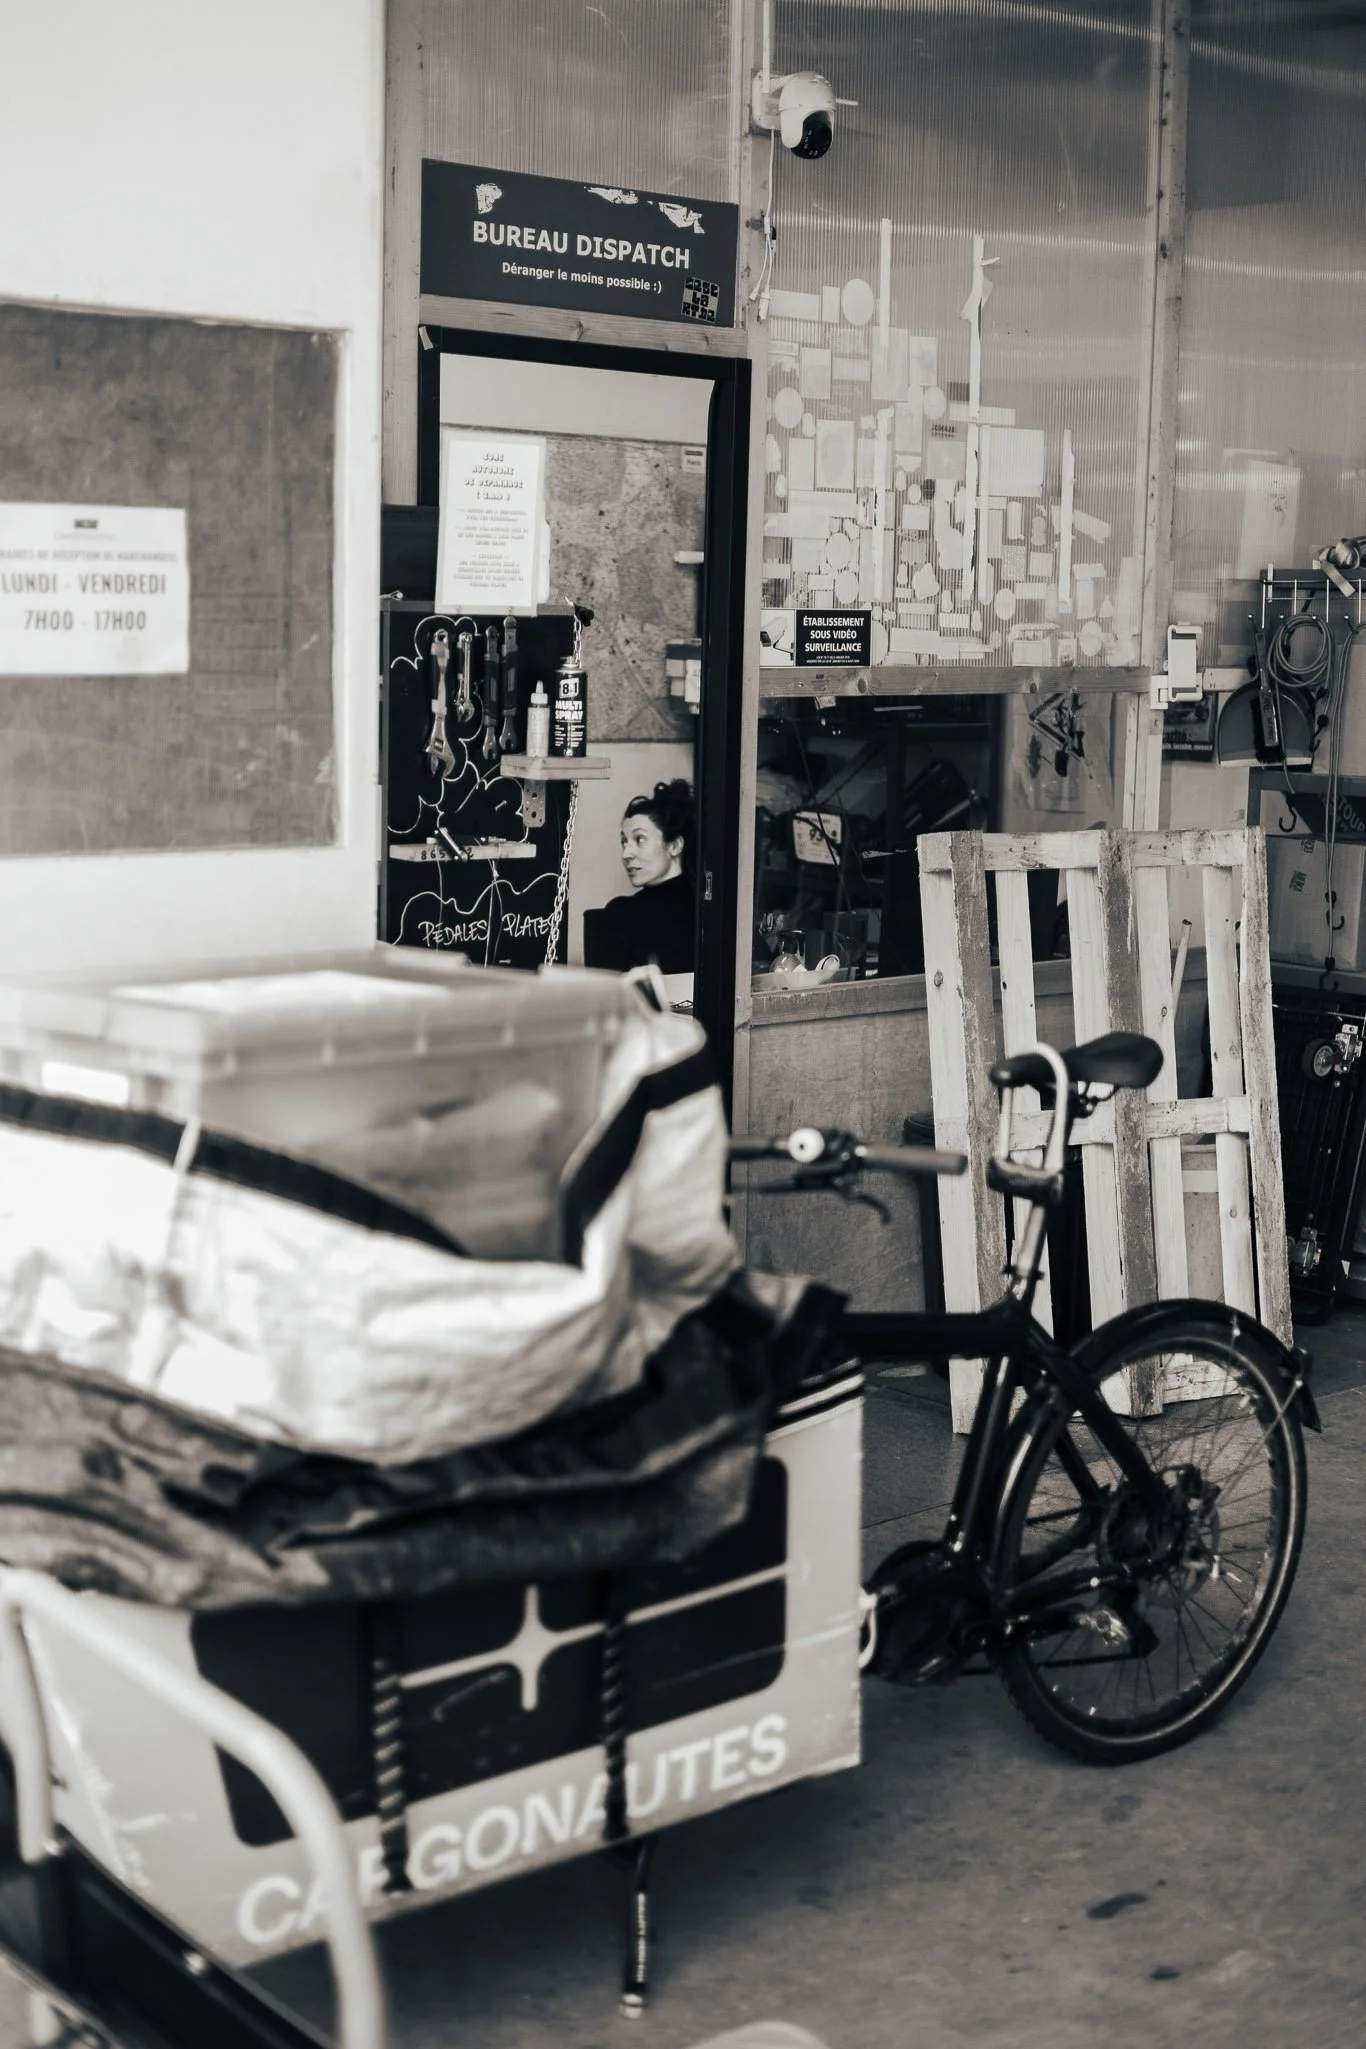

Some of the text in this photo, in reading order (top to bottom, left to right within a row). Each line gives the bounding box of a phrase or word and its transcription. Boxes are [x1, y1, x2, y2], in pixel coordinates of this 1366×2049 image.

[473, 220, 690, 269] BUREAU DISPATCH
[502, 261, 554, 280] Déranger
[557, 268, 567, 280] le
[571, 271, 603, 285] moins
[606, 275, 650, 291] possible
[1, 573, 58, 595] LUNDI
[78, 573, 166, 595] VENDREDI
[24, 610, 74, 631] 7H00
[94, 610, 147, 631] 17H00
[803, 616, 864, 626] ÉTABLISSEMENT
[810, 629, 857, 639] SOUS VIDÉO
[804, 643, 862, 652] SURVEILLANCE
[555, 700, 582, 710] MULTI
[555, 710, 583, 720] SPRAY
